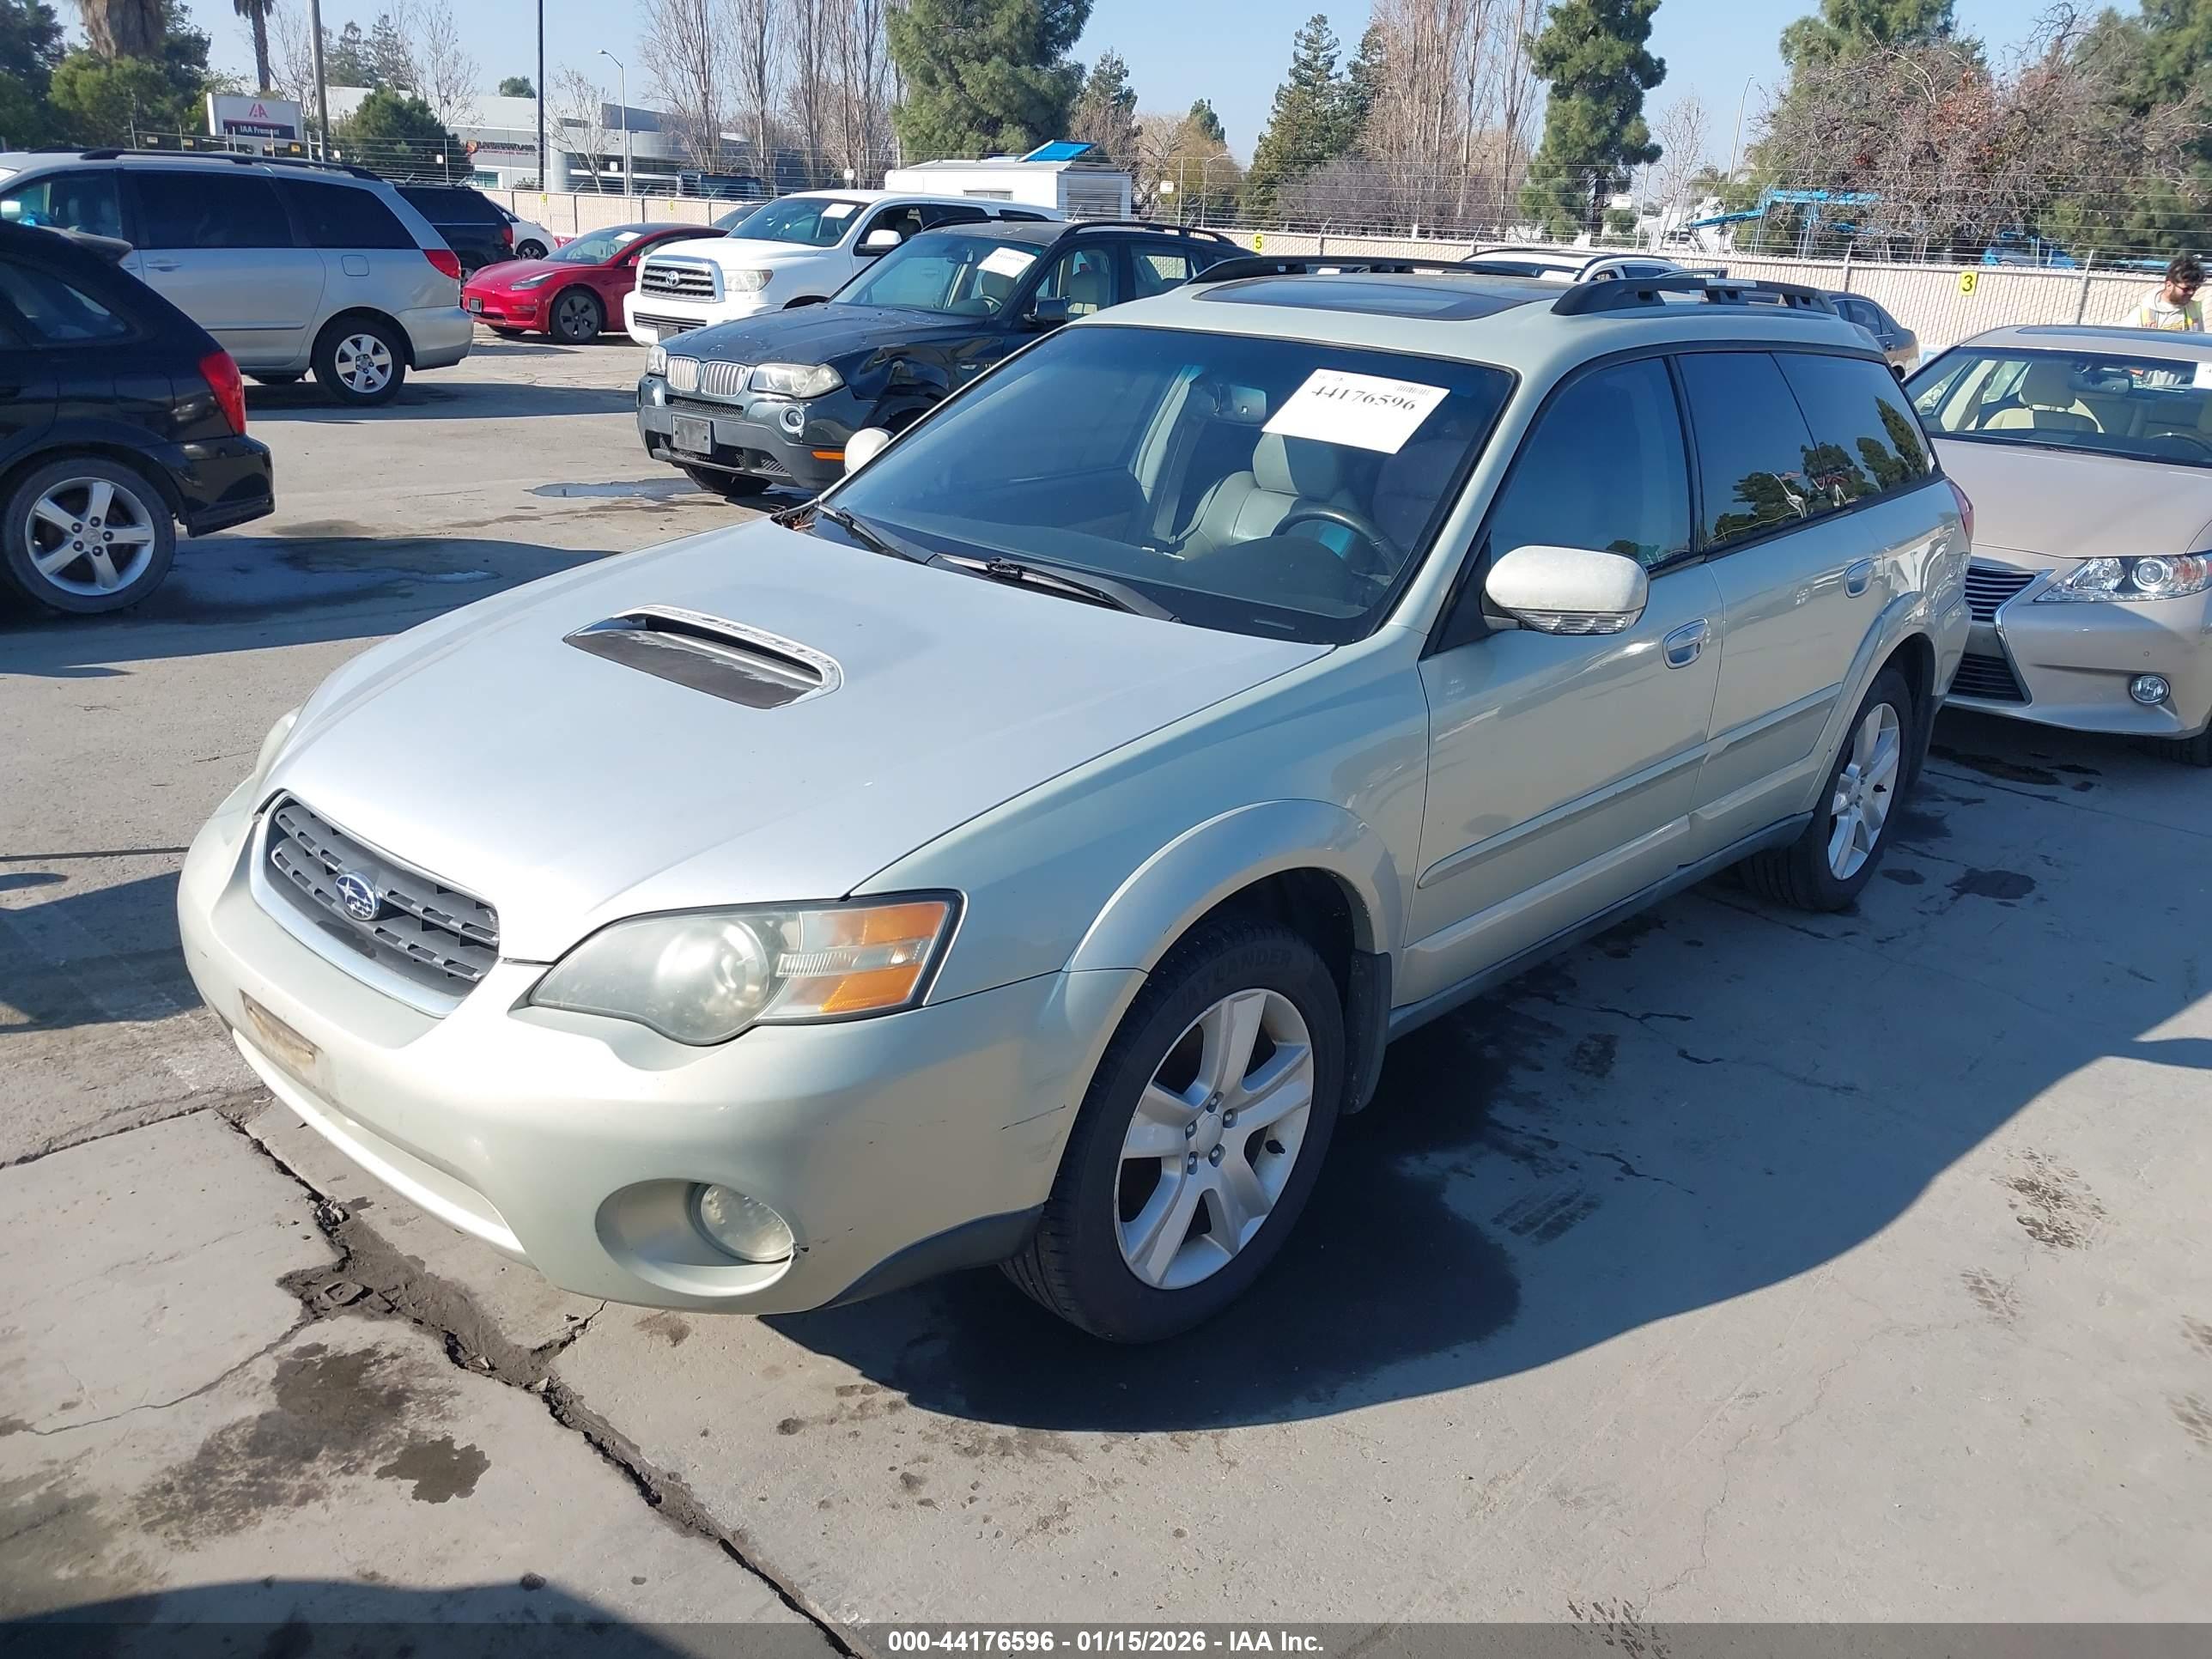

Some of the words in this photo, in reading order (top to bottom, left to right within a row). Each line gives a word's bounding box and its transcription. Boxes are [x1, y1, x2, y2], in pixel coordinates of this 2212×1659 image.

[1255, 236, 1262, 249] 5
[1962, 275, 1973, 292] 3
[1311, 386, 1416, 410] 44176596
